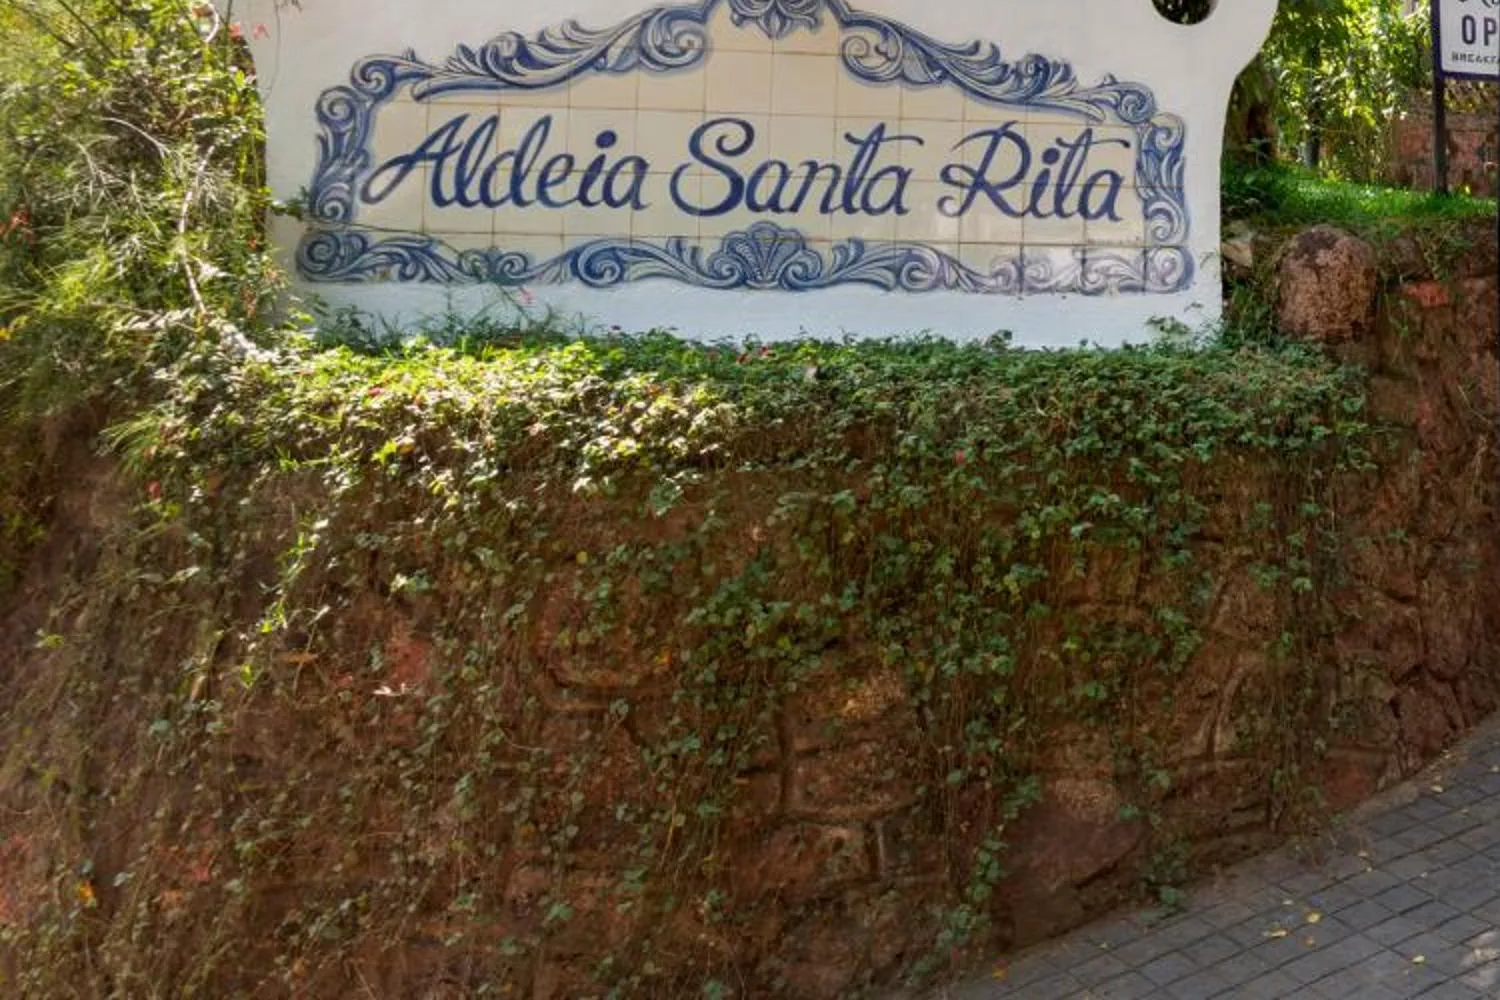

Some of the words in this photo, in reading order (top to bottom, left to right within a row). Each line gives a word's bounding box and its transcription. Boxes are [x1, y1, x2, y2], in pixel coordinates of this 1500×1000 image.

[361, 113, 652, 211] Aldeia
[669, 117, 924, 217] Santa
[937, 120, 1131, 221] Rita
